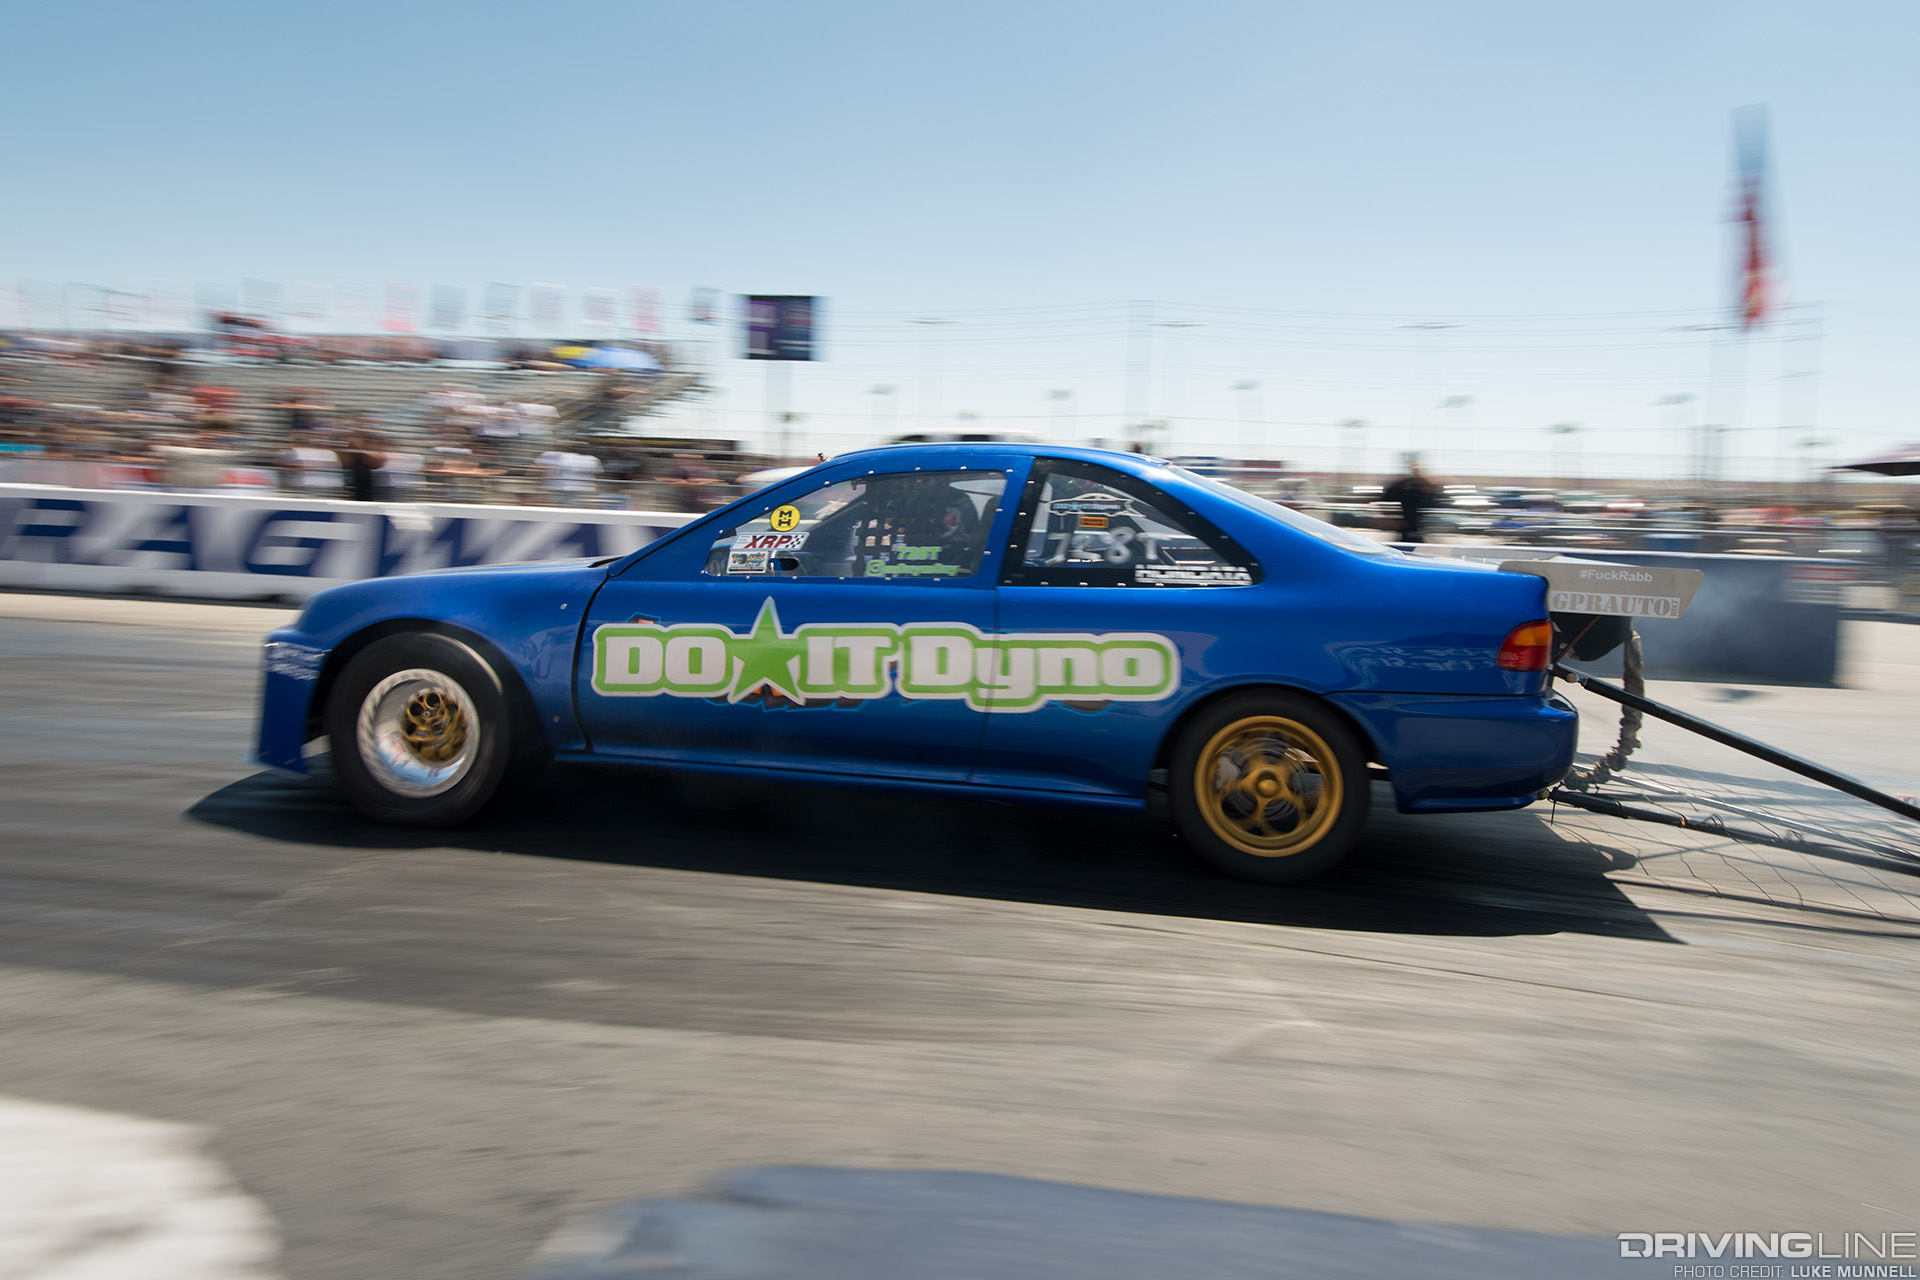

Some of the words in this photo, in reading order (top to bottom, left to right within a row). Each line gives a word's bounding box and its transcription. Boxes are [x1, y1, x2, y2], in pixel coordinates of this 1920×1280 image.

[743, 535, 793, 549] XRP
[1578, 568, 1654, 583] #FuckRabb
[1552, 592, 1670, 616] GPRAUTO
[600, 630, 734, 690] DO
[803, 630, 893, 690] IT
[907, 630, 1170, 701] Dyno
